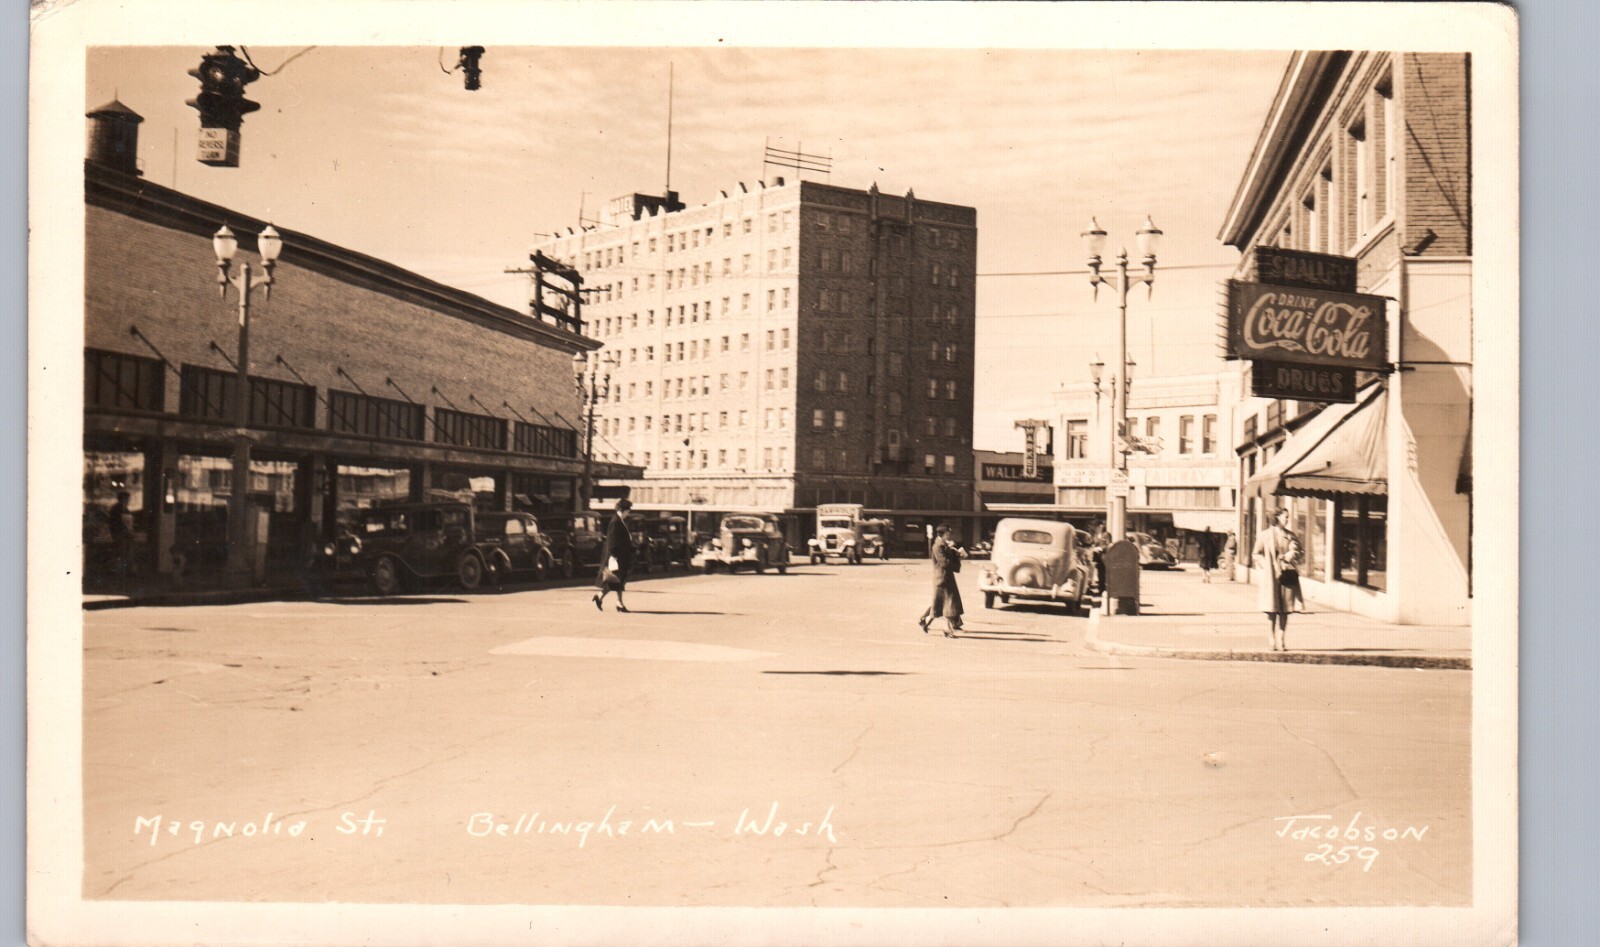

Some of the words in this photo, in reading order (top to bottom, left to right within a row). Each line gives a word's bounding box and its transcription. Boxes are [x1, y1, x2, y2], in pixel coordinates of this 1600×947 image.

[1278, 293, 1318, 307] DRINK
[1277, 368, 1344, 394] DRUGS
[985, 466, 1044, 480] WALLE
